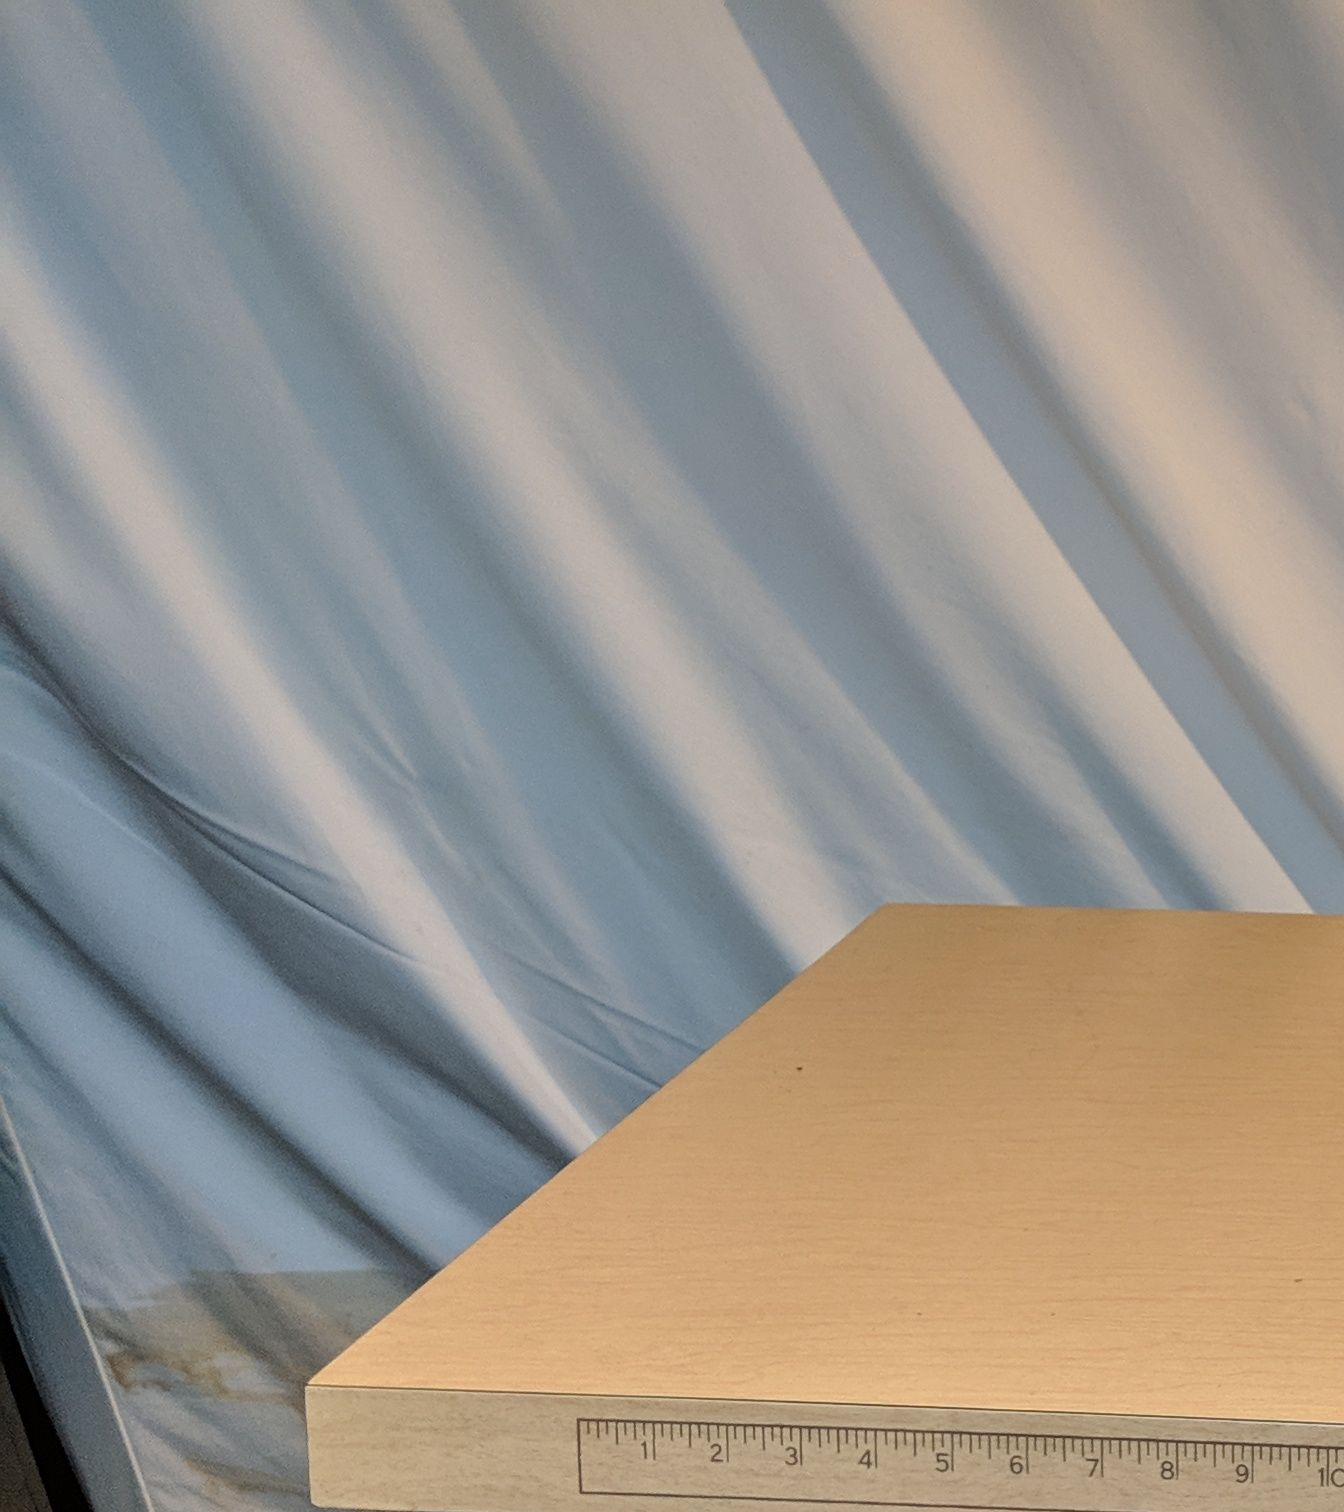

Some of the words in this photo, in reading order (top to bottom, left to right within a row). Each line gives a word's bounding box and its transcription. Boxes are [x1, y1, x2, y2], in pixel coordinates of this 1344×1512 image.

[641, 1443, 649, 1460] 1
[709, 1443, 724, 1463] 2
[785, 1446, 799, 1466] 3
[858, 1449, 874, 1468] 4
[935, 1453, 950, 1473] 5
[1009, 1455, 1024, 1475] 6
[1085, 1458, 1100, 1479] 7
[1160, 1460, 1175, 1480] 8
[1236, 1465, 1250, 1485] 9
